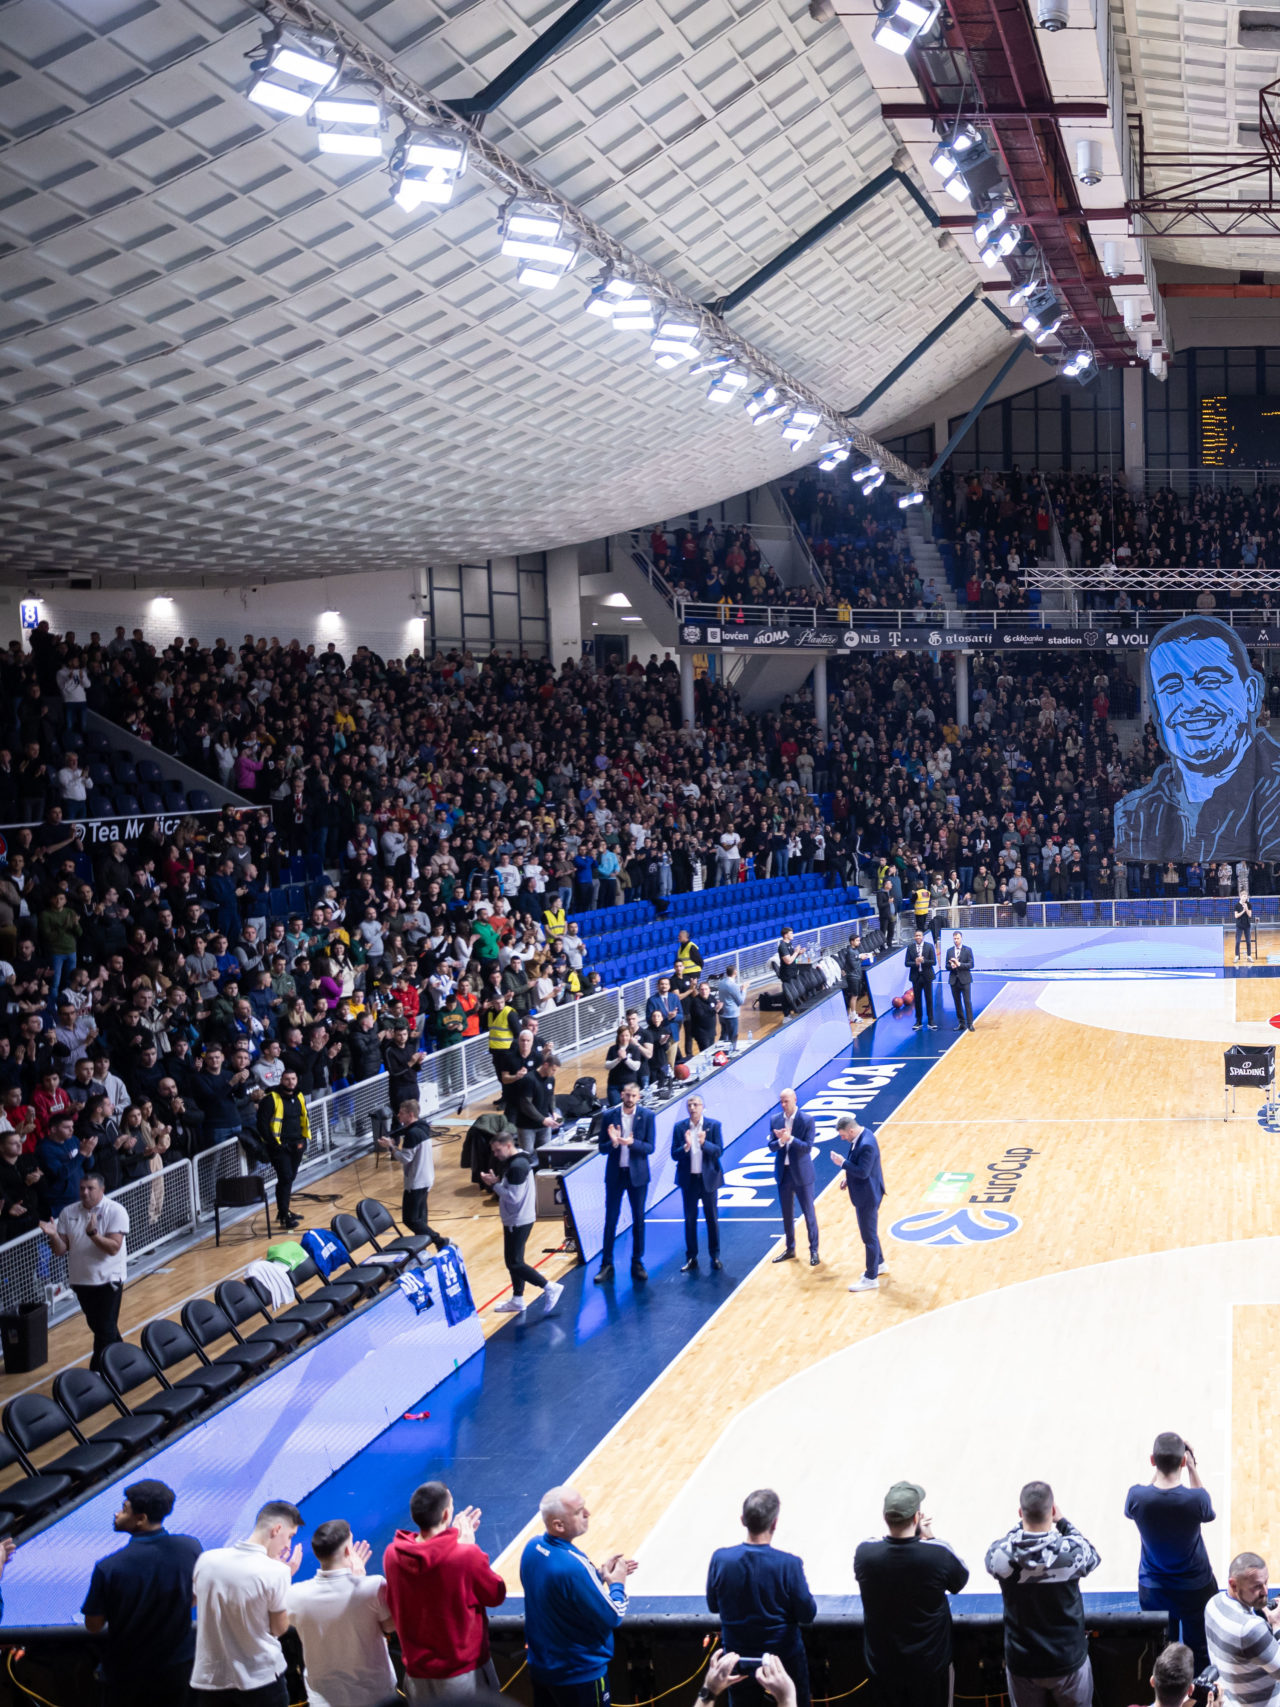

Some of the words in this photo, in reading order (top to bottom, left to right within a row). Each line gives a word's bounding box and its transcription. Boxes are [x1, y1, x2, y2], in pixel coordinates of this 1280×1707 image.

[25, 604, 35, 622] 8
[753, 629, 790, 644] AROMA
[861, 634, 880, 643] NLB
[1048, 635, 1082, 644] stadion
[1121, 634, 1149, 645] VOLI
[584, 641, 592, 651] 7
[88, 821, 119, 843] Tea
[1229, 1066, 1265, 1077] SPALDING
[969, 1147, 1041, 1204] EuroCup
